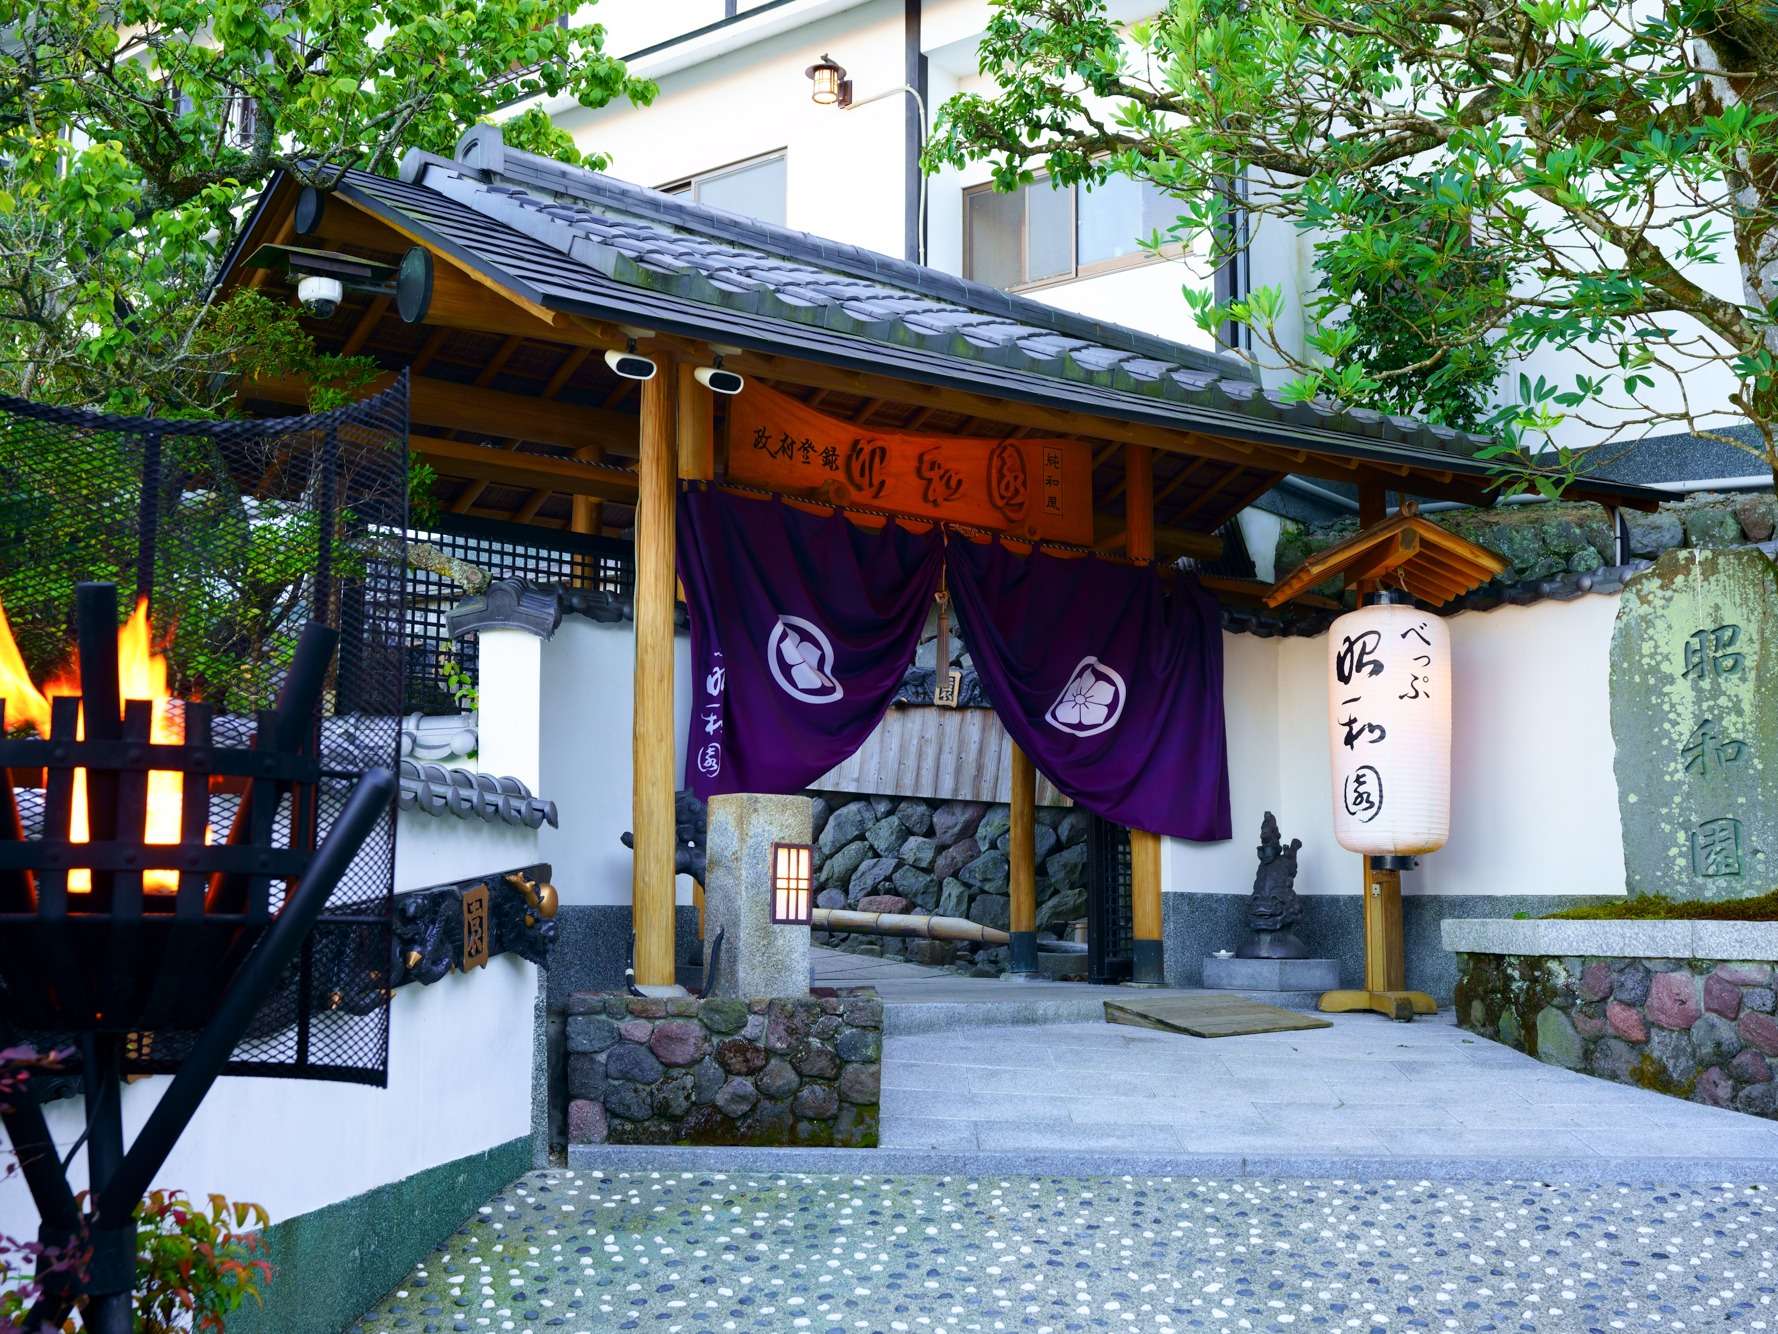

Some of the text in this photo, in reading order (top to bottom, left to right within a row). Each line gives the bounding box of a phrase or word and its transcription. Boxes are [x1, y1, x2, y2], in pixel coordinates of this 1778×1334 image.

[1398, 622, 1431, 700] べっぷ
[1681, 623, 1749, 878] 昭和園
